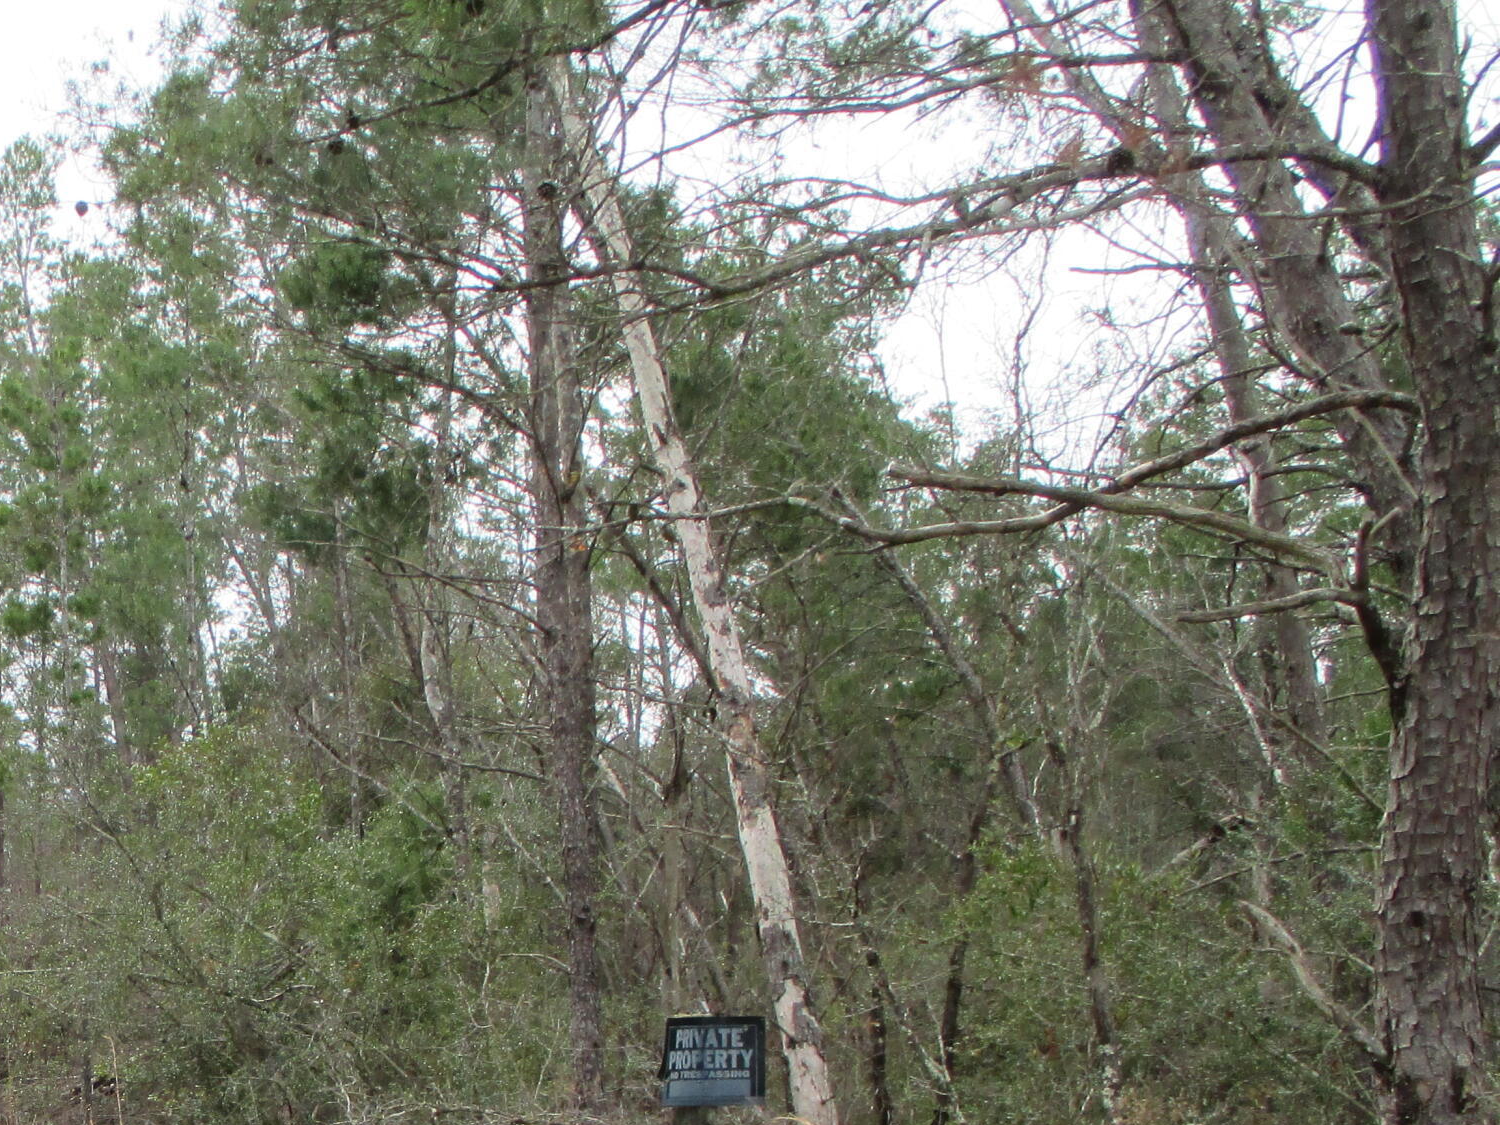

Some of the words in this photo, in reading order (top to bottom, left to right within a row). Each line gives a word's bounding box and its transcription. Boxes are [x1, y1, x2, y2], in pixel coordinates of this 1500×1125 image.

[676, 1028, 743, 1048] PRIVATE
[669, 1049, 753, 1070] PROPERTY
[670, 1071, 679, 1079] NO
